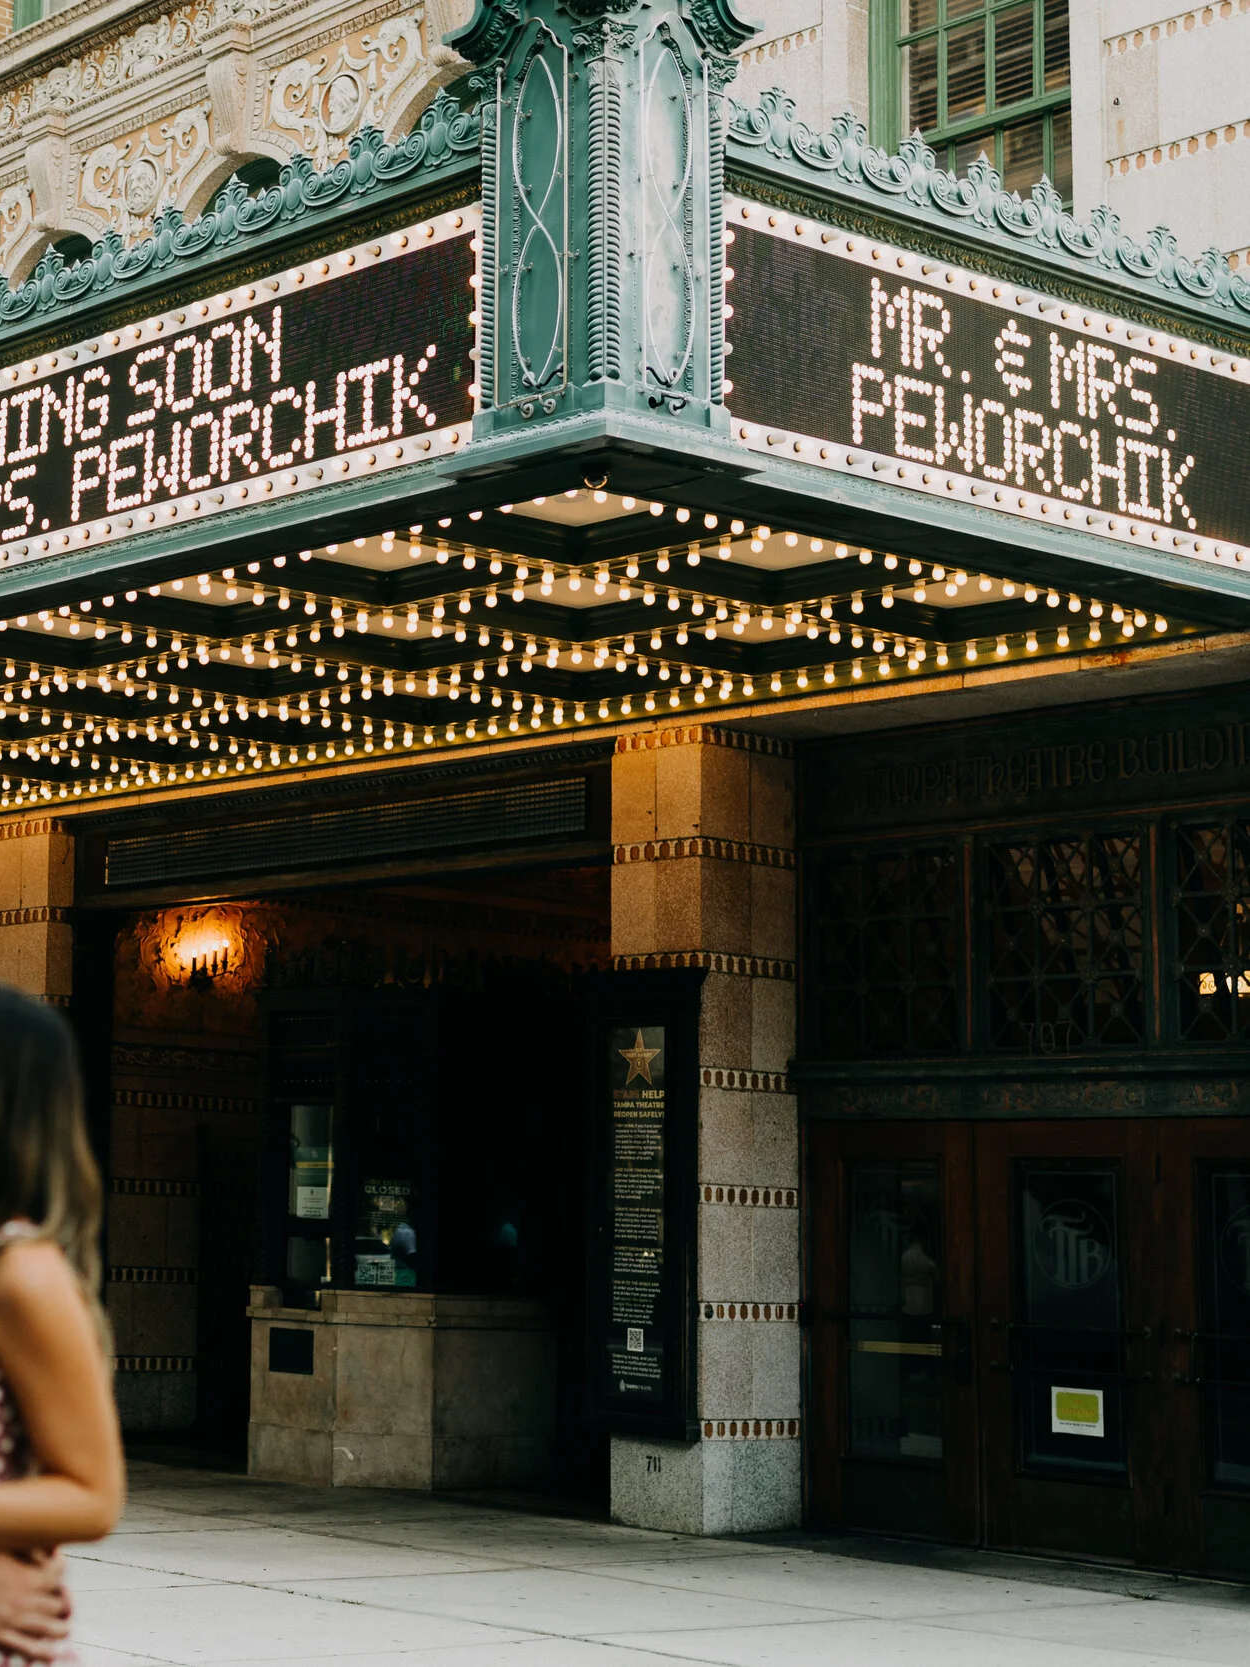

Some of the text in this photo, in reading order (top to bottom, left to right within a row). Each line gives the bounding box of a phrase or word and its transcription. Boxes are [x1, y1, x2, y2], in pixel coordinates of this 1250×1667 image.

[127, 305, 283, 428] SOON
[870, 276, 1177, 443] MR. & MRS.
[70, 343, 437, 522] PEWORCHIK
[852, 361, 1197, 530] PEWORCHIK
[860, 757, 960, 814] TAMPA
[963, 740, 1107, 800] THEATRE
[613, 1101, 666, 1110] TAMPA THEATRE
[613, 1110, 665, 1119] REOPEN SAFELY!
[641, 1089, 666, 1100] HELP
[364, 1185, 411, 1196] CLOSED
[645, 1455, 662, 1473] 711
